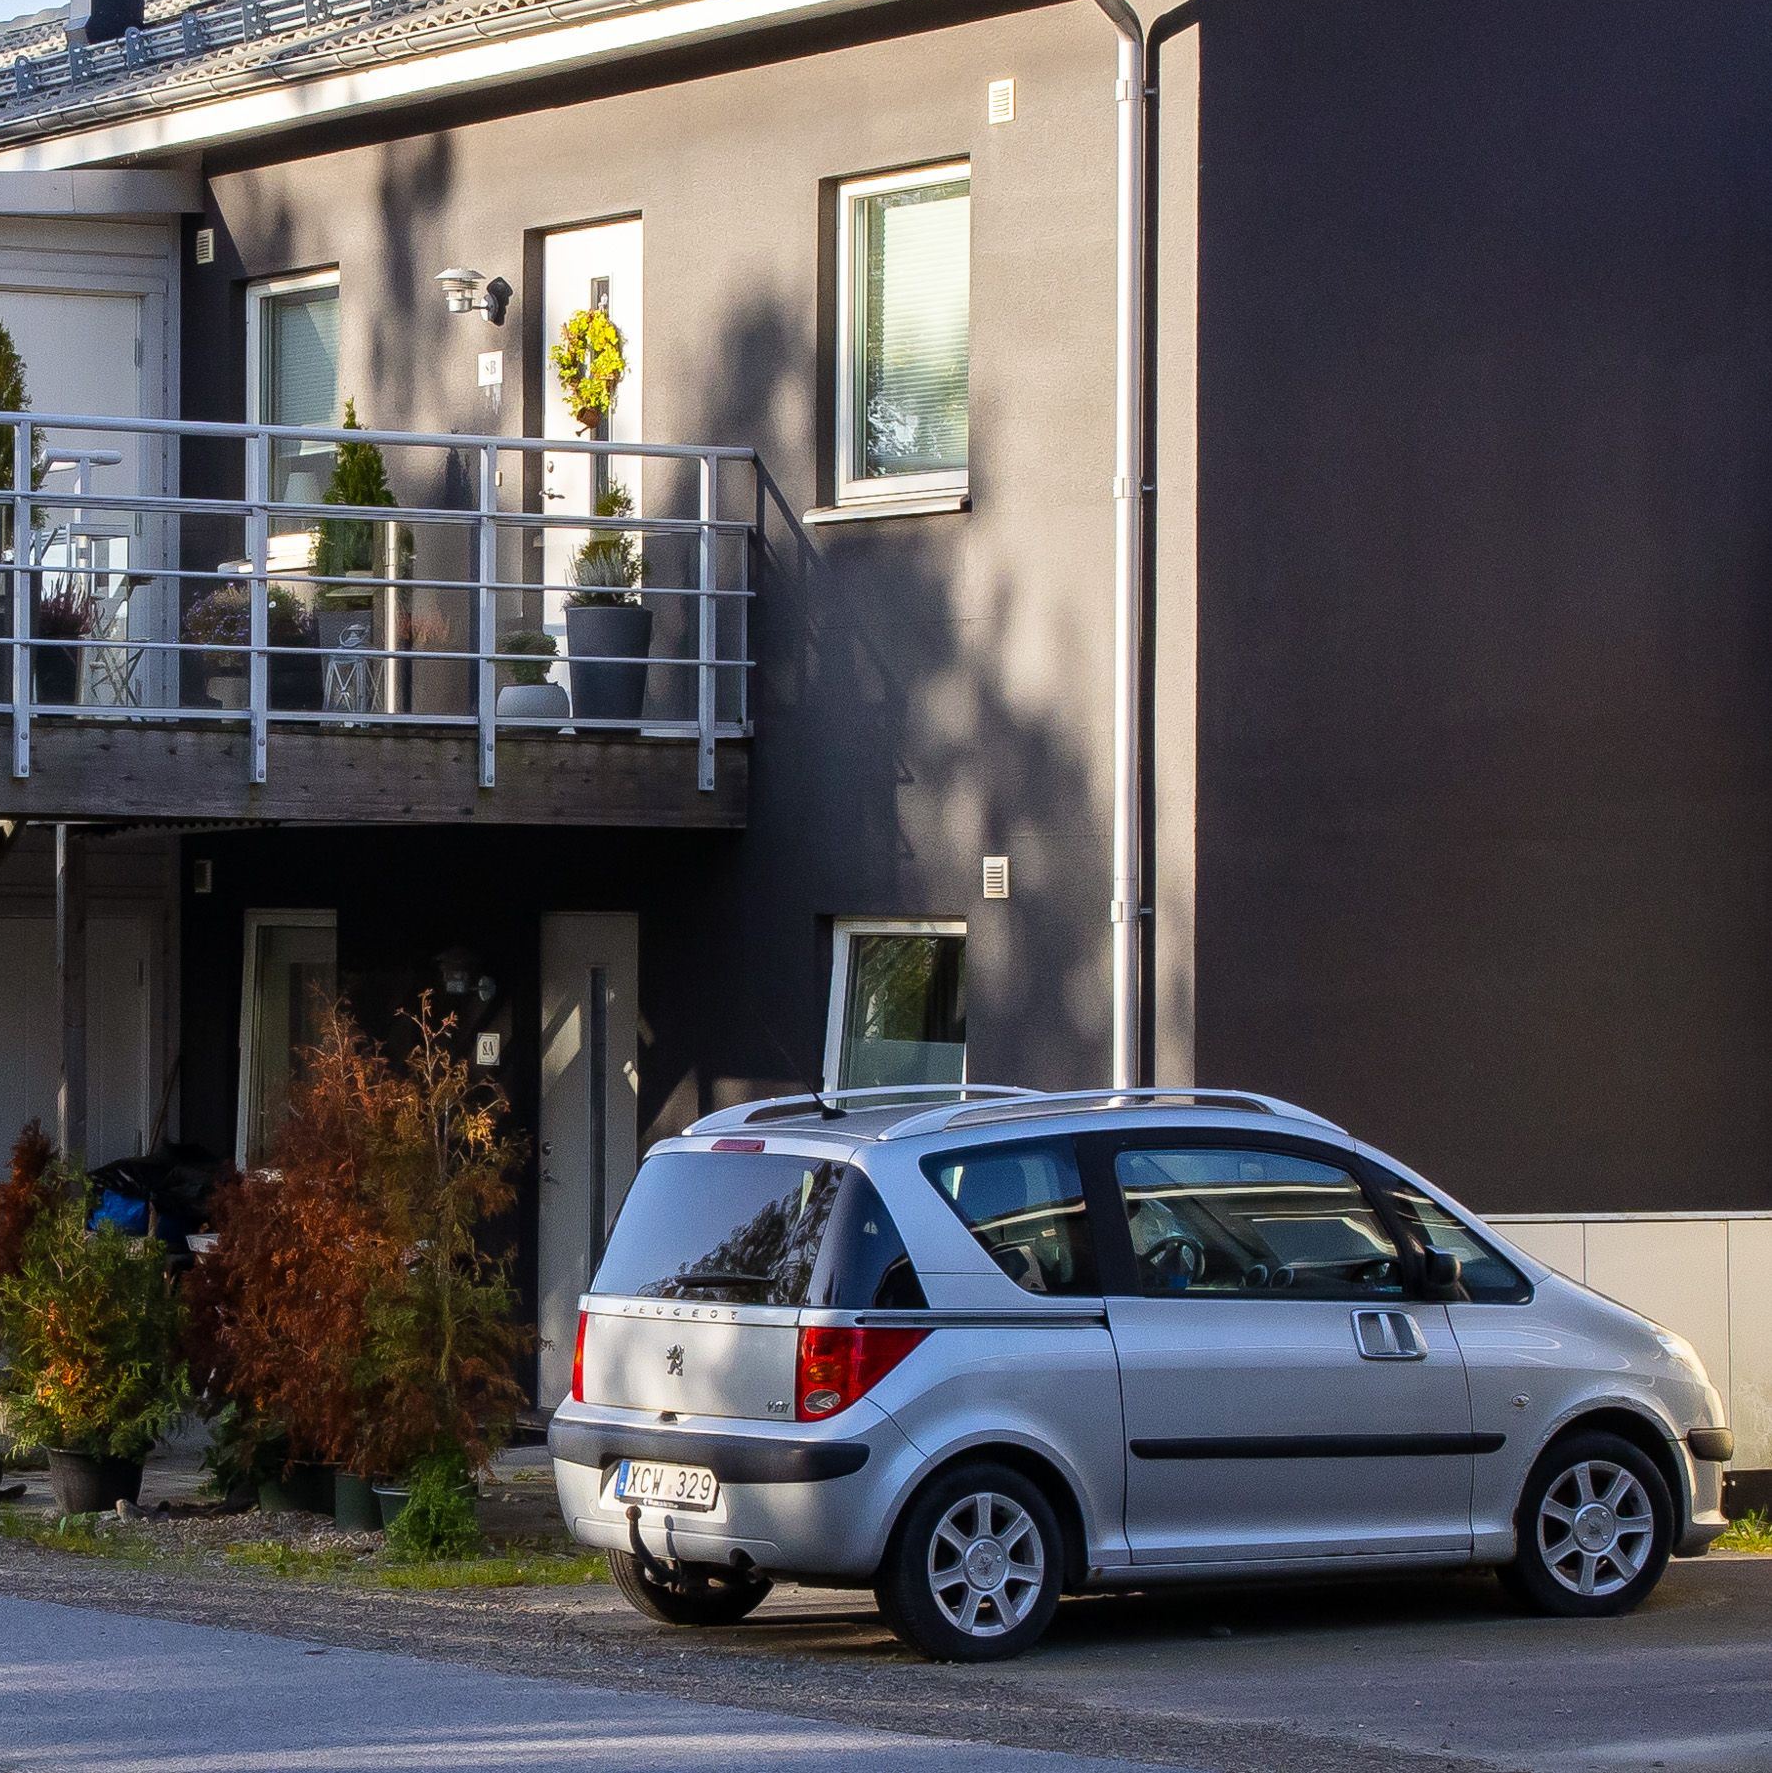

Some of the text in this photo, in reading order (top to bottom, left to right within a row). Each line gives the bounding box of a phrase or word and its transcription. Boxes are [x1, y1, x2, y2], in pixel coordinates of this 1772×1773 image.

[622, 1304, 738, 1321] PEUGEOT
[627, 1465, 712, 1500] XCW 329
